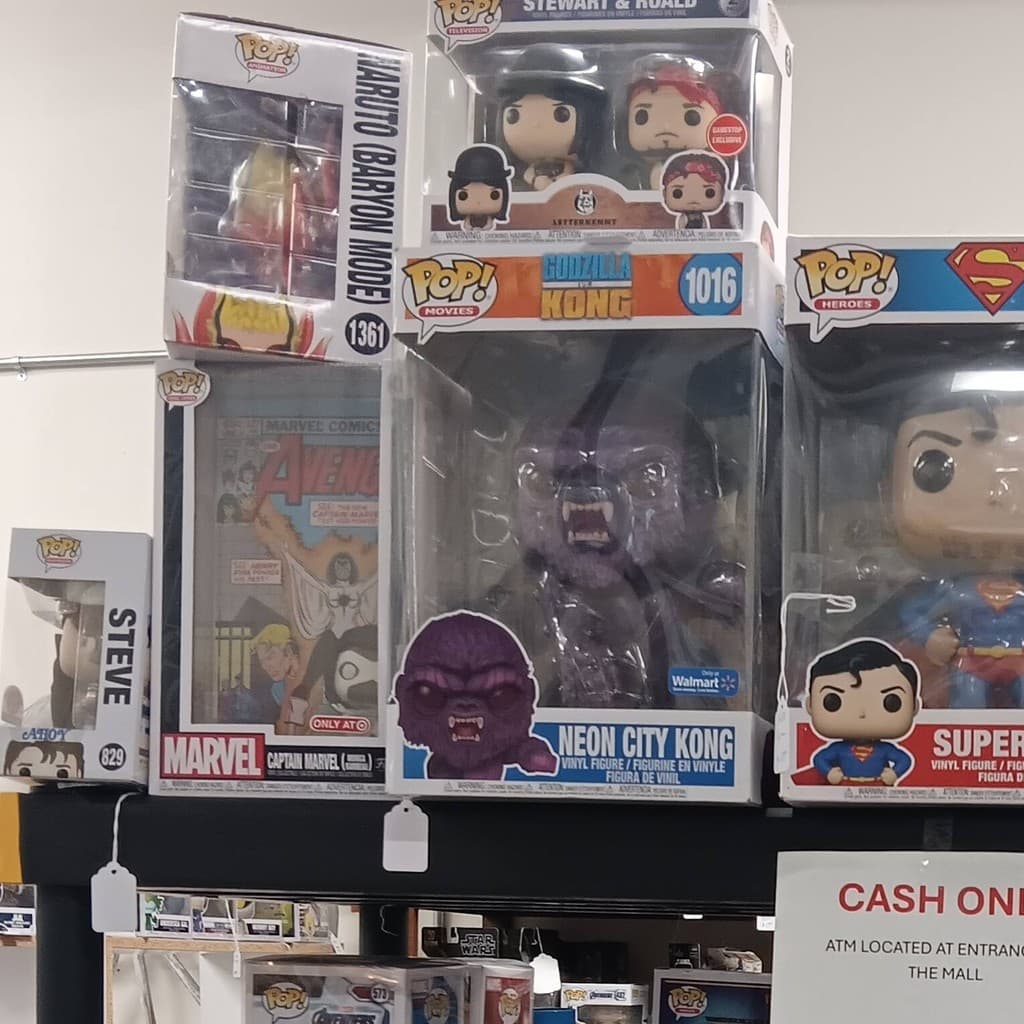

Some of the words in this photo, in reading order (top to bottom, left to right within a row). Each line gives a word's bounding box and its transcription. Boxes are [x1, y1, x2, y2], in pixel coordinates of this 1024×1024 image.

[235, 32, 300, 67] POP!
[348, 141, 398, 236] (BARYON
[346, 236, 392, 305] MODE)
[405, 254, 496, 304] POP!
[543, 253, 632, 281] GODZILLA
[795, 248, 899, 299] POP!
[685, 267, 737, 304] 1016
[423, 306, 478, 317] MOVIES
[541, 290, 633, 320] KONG
[821, 300, 874, 310] HEROES
[348, 319, 386, 349] 1361
[159, 369, 206, 396] POP!
[36, 535, 83, 559] POP!
[103, 607, 137, 706] STEVE
[671, 675, 720, 689] Walmart
[312, 719, 340, 730] ONLY
[342, 719, 356, 730] AT
[100, 746, 124, 766] 829
[163, 736, 262, 776] MARVEL
[559, 725, 619, 759] NEON
[622, 725, 668, 759] CITY
[675, 727, 734, 761] KONG
[267, 752, 302, 770] CAPTAIN
[305, 752, 341, 771] MARVEL
[561, 758, 589, 771] VINYL
[591, 758, 624, 772] FIGURE
[633, 758, 677, 772] FIGURINE
[679, 759, 691, 772] EN
[692, 759, 726, 773] VINYLE
[931, 759, 959, 772] VINYL
[961, 759, 998, 772] FIGURE
[606, 771, 641, 784] FIGURA
[642, 771, 656, 784] DE
[657, 771, 681, 785] VINIL
[978, 771, 1015, 784] FIGURA
[838, 882, 945, 914] CASH
[825, 938, 857, 954] ATM
[861, 940, 932, 956] LOCATED
[936, 942, 954, 956] AT
[908, 965, 939, 980] THE
[942, 967, 984, 981] MALL
[264, 985, 308, 1011] POP!
[669, 988, 707, 1010] POP!
